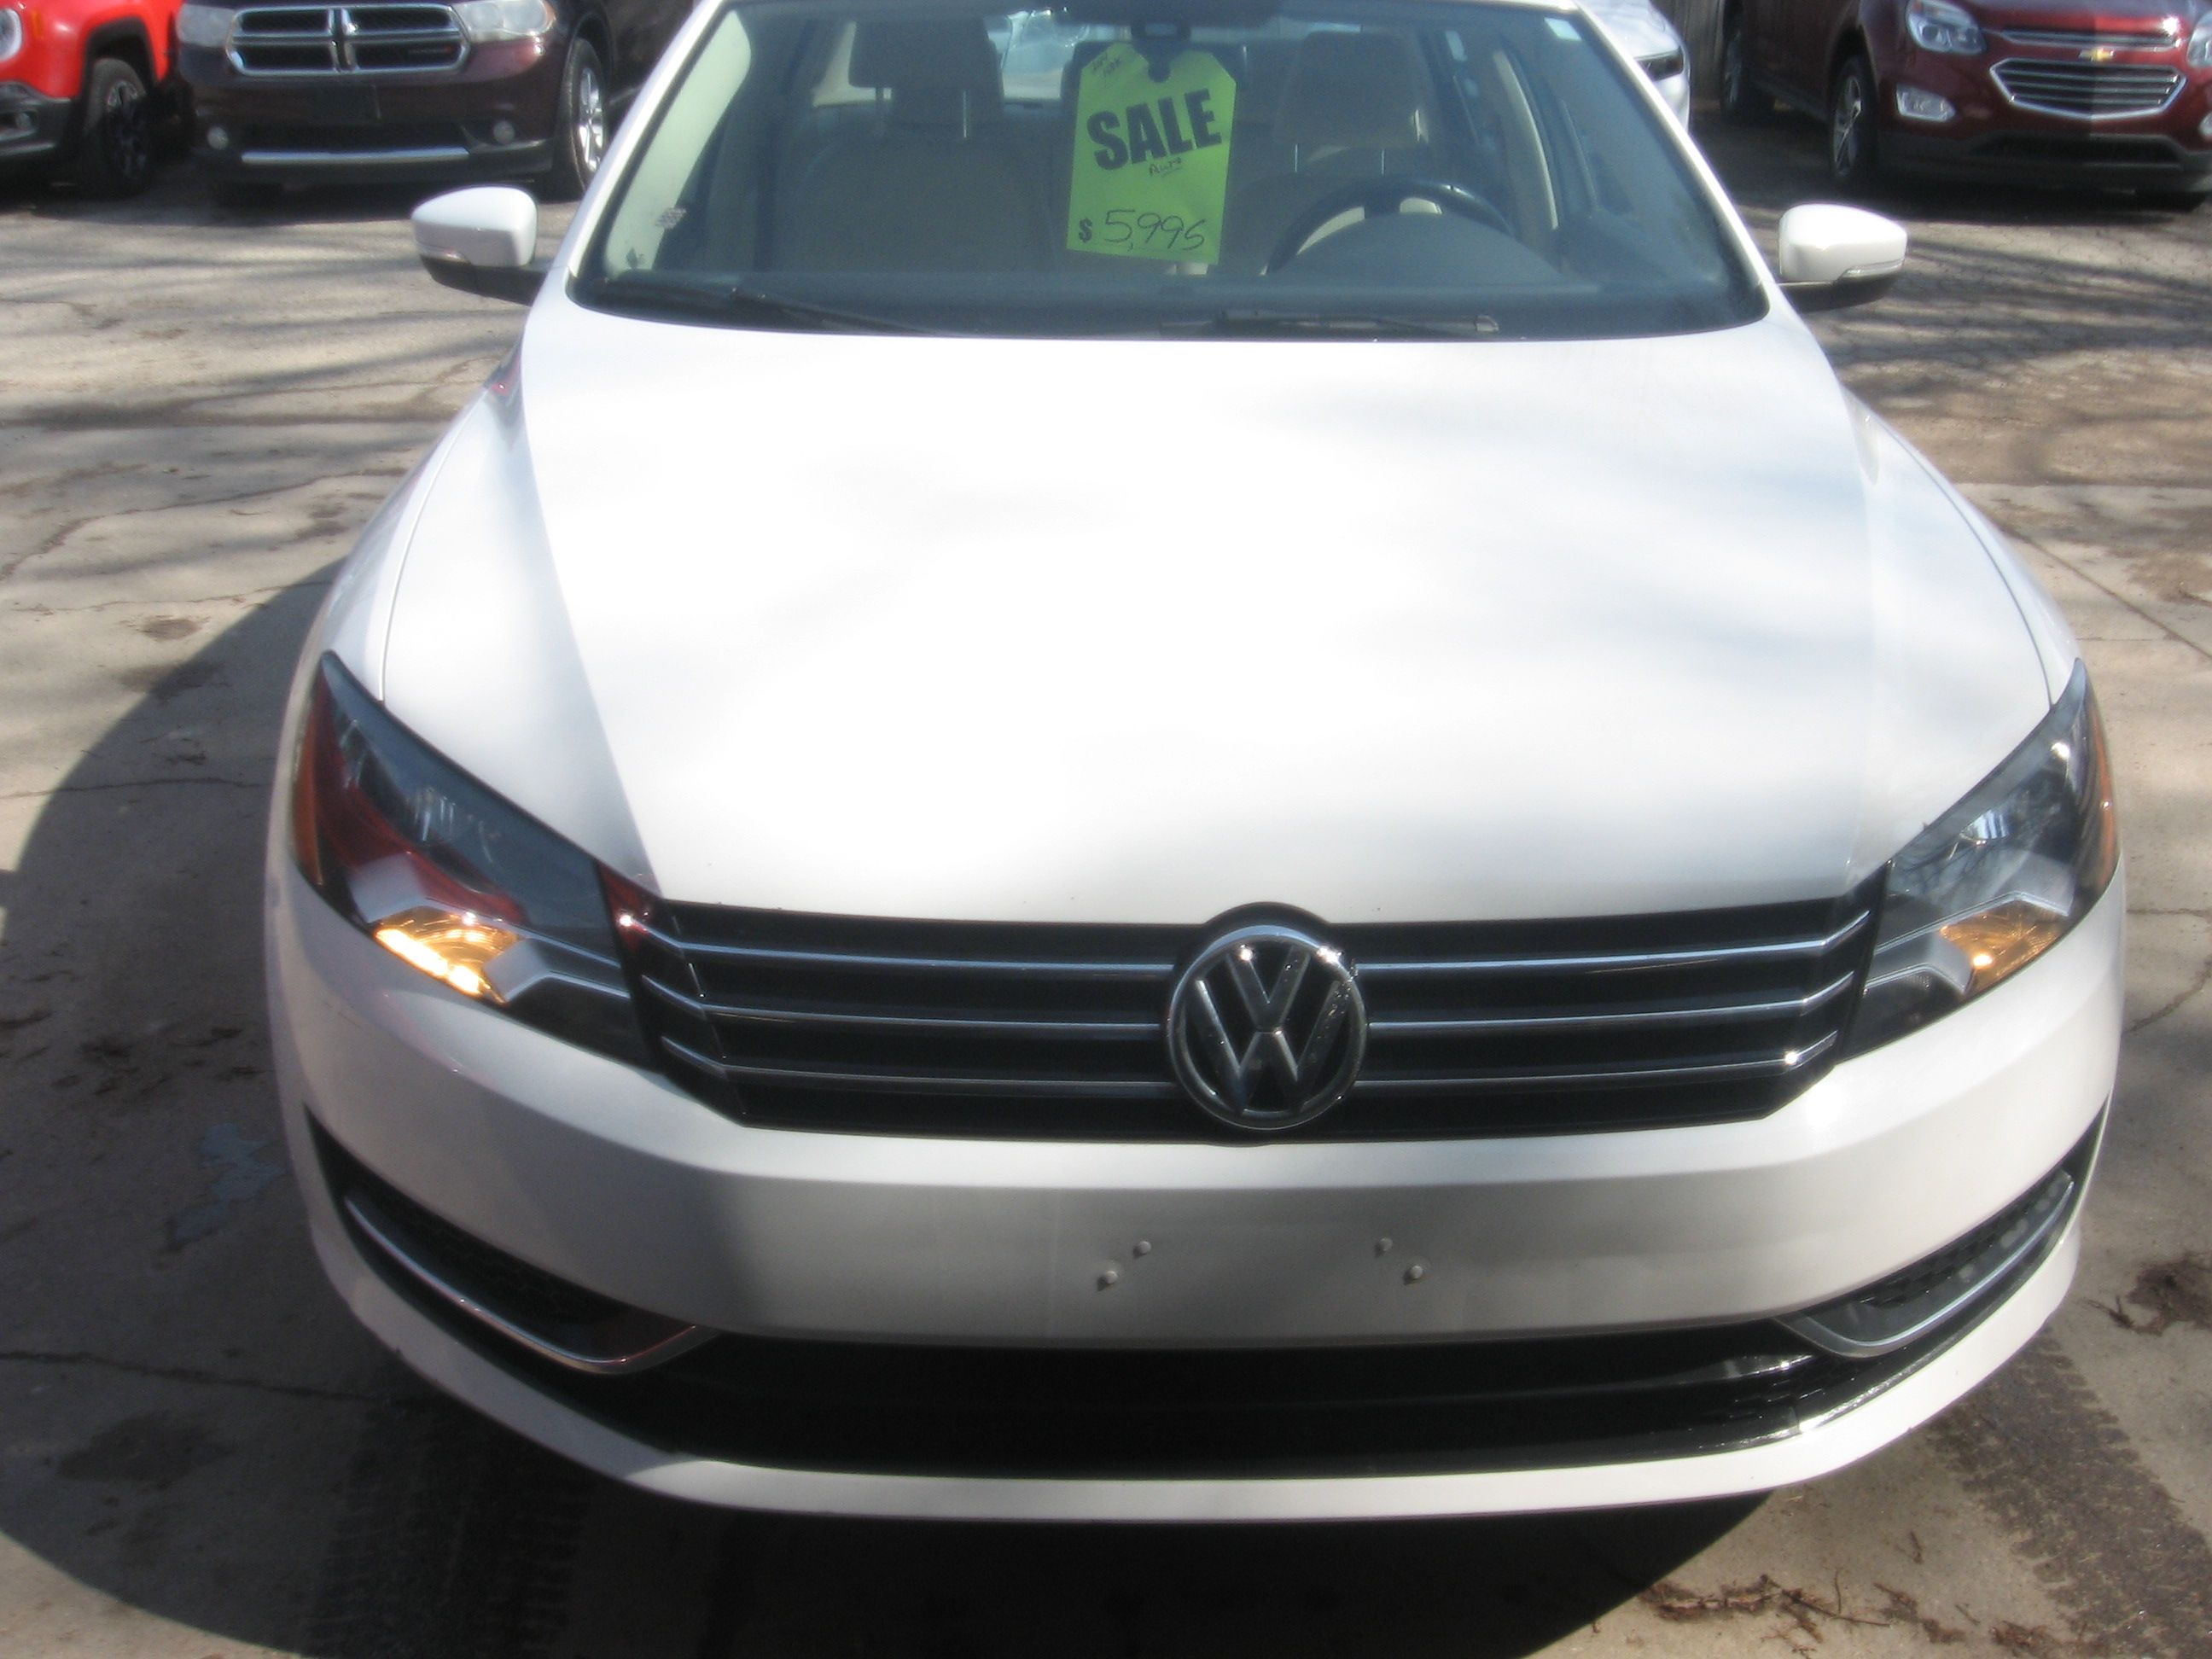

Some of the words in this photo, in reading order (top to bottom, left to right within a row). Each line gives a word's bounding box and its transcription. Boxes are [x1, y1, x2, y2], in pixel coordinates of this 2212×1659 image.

[1086, 88, 1223, 171] SALE
[1079, 217, 1092, 242] $
[1183, 937, 1355, 1115] VW
